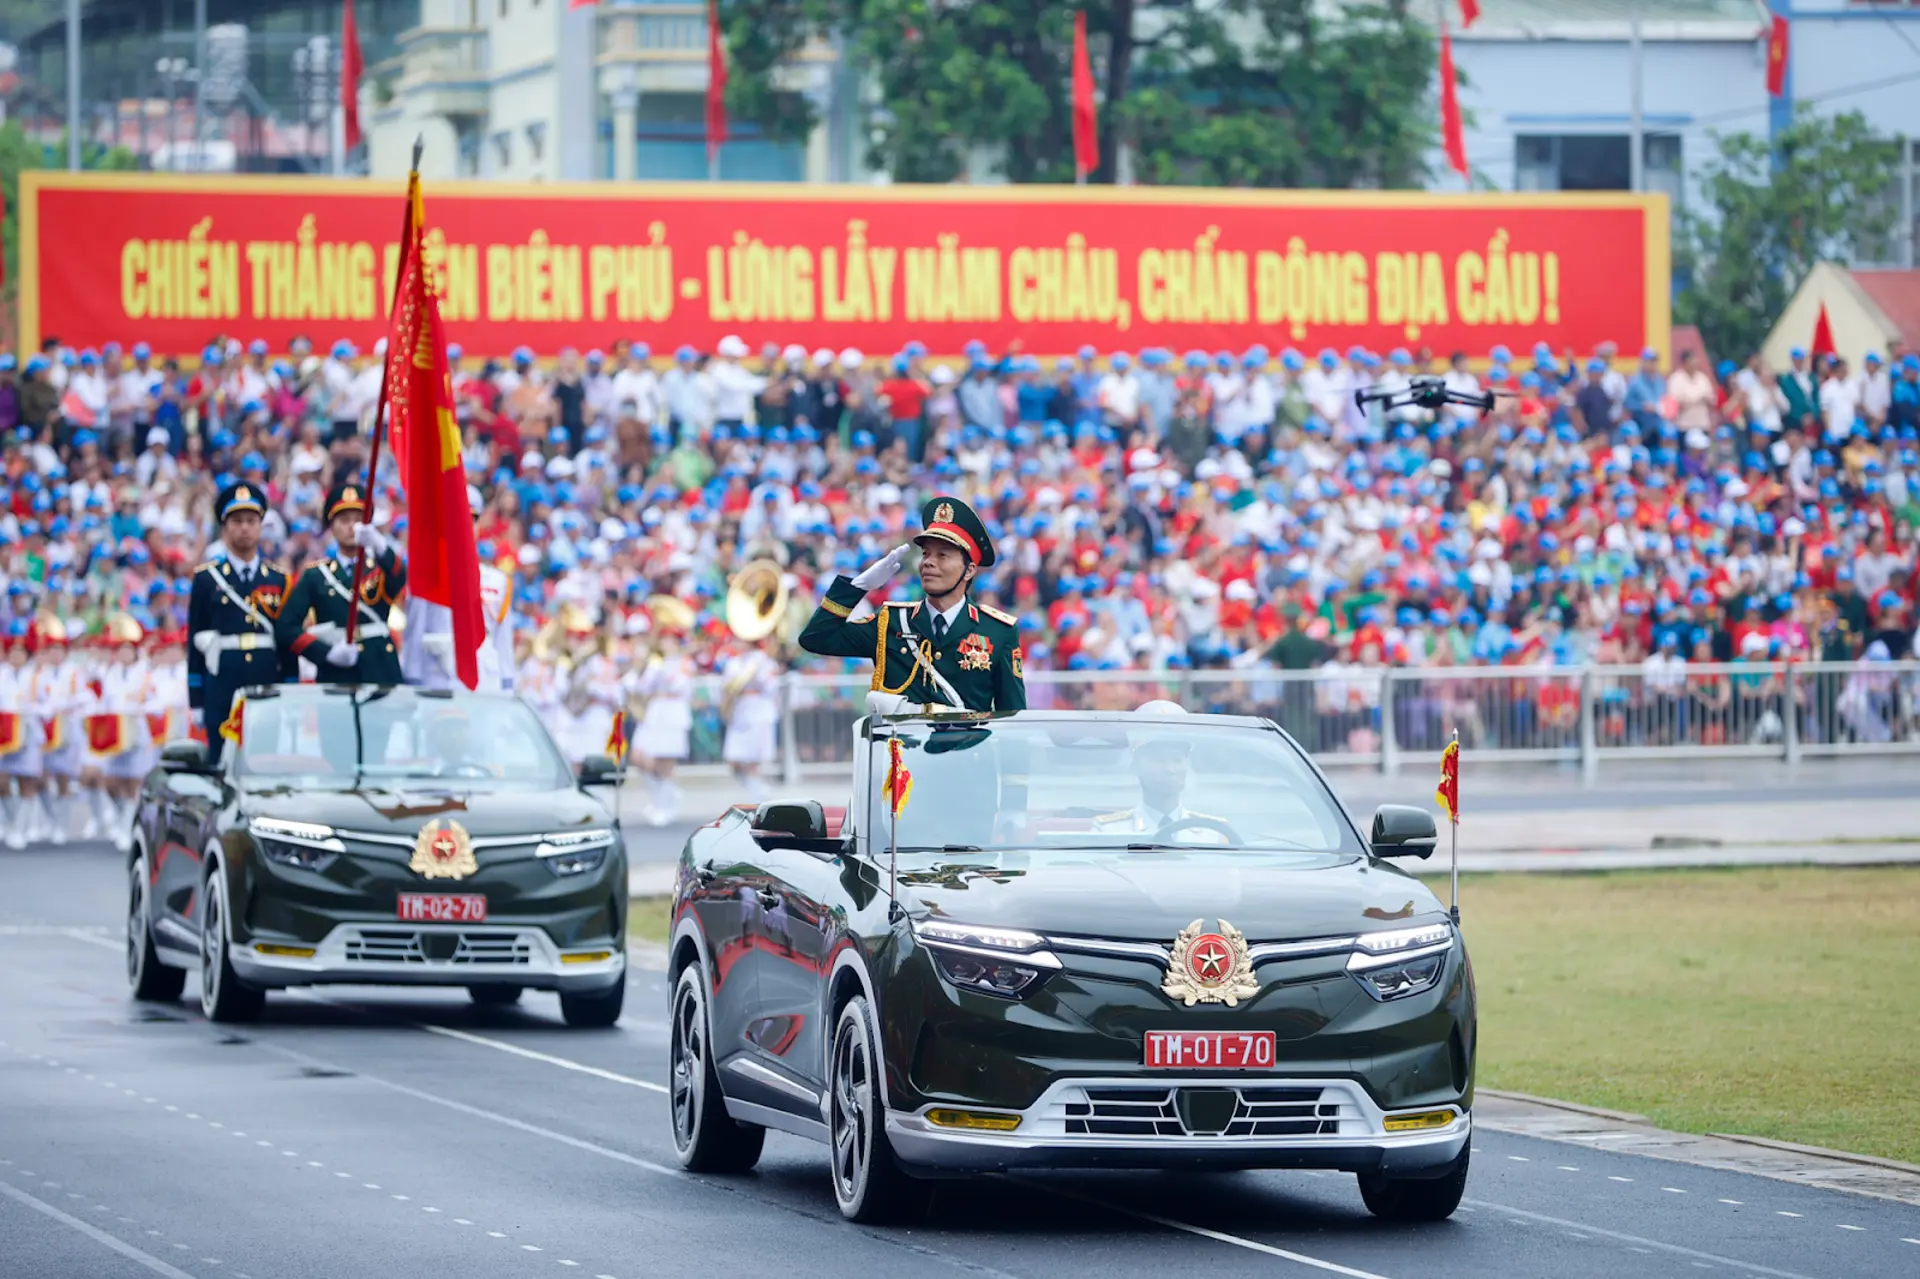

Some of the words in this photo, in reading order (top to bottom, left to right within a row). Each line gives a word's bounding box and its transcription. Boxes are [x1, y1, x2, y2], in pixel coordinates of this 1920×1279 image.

[121, 215, 240, 319] CHIẾN
[246, 213, 376, 320] THẮNG
[486, 229, 584, 321] BIÊN
[589, 220, 674, 322] PHỦ
[706, 229, 816, 322] LỪNG
[820, 218, 898, 322] LẪY
[903, 232, 1002, 322] NĂM
[1008, 232, 1132, 330] CHÂU,
[1137, 224, 1250, 324] CHẤN
[1254, 236, 1369, 340] ĐỘNG
[1375, 251, 1449, 341] ĐỊA
[399, 894, 485, 920] TM-02-70
[1149, 1035, 1271, 1065] TM-01-70
